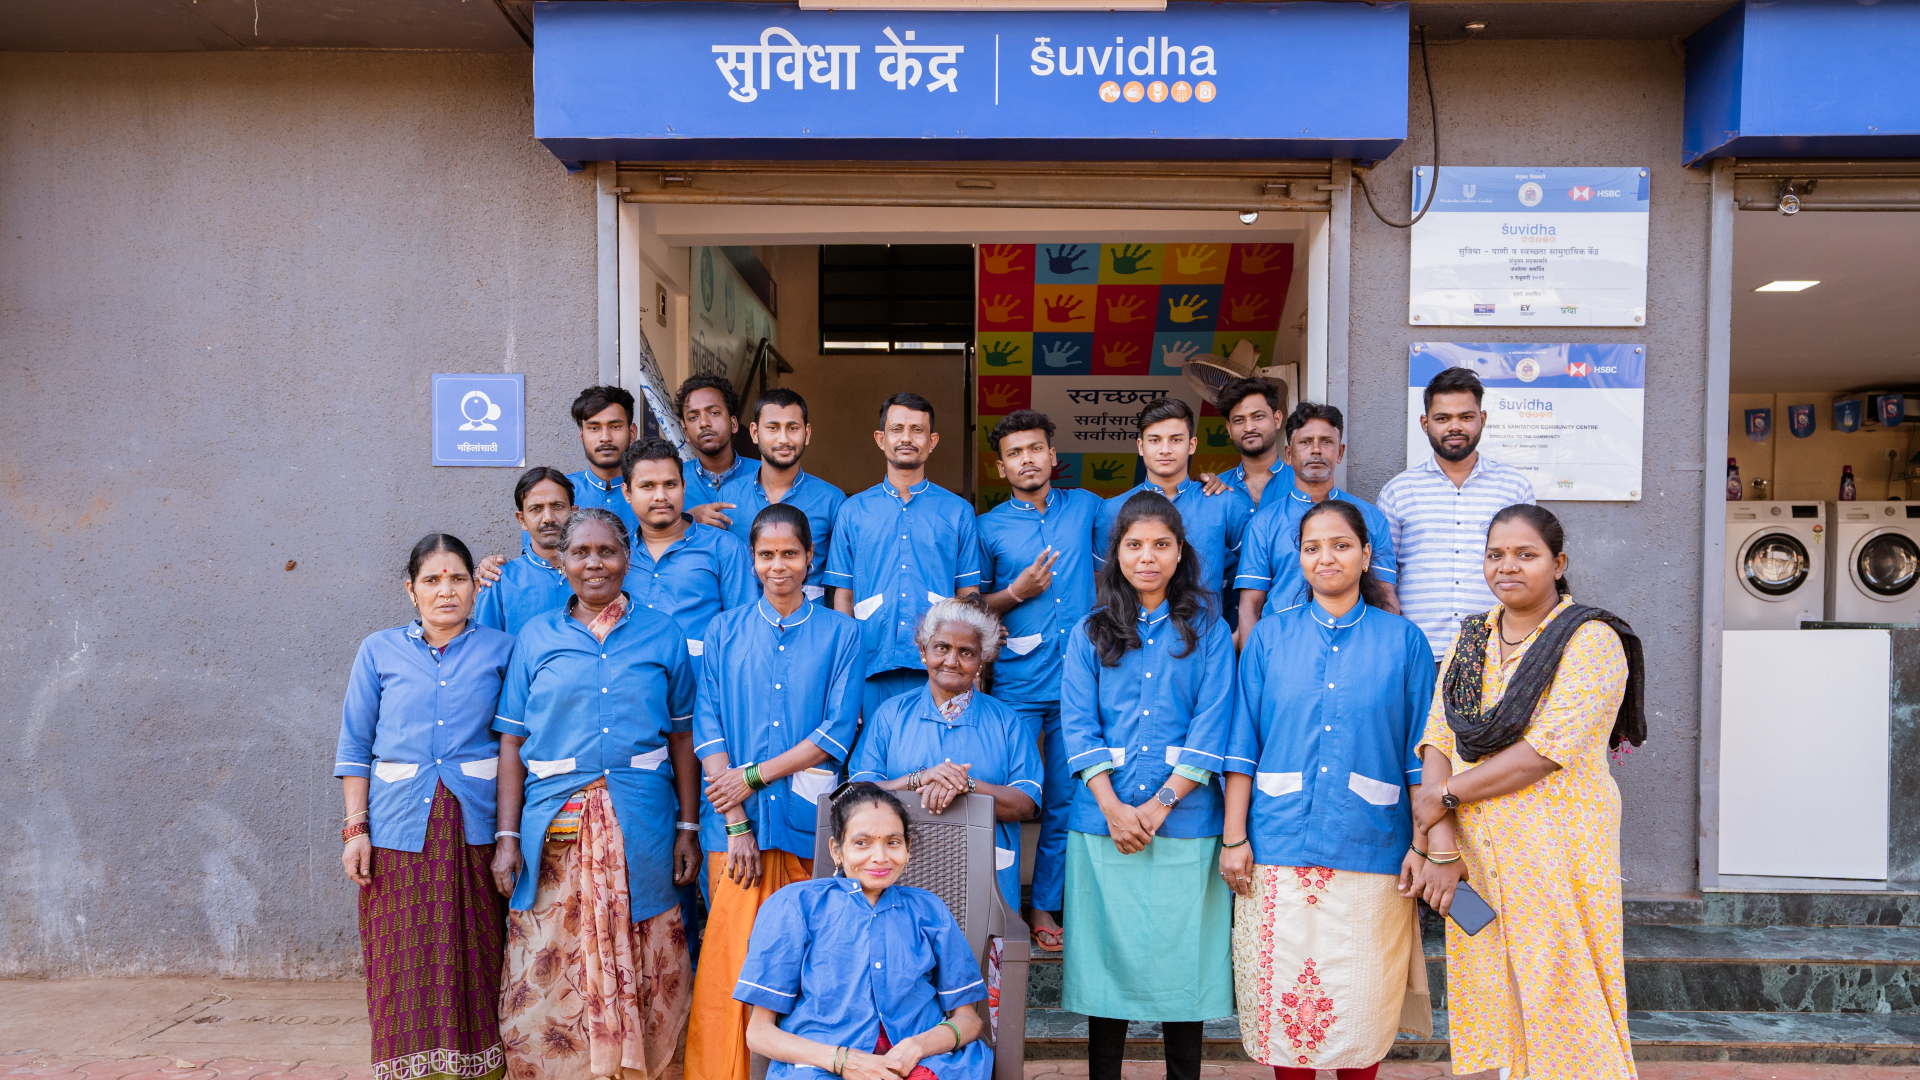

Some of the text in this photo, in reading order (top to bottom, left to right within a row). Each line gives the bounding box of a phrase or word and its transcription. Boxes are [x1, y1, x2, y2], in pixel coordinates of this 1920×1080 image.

[711, 26, 964, 103] सुविधा केंद्र
[1597, 189, 1621, 198] HSBC
[1458, 246, 1481, 257] सुविधा
[1491, 246, 1509, 255] पाणी
[1519, 248, 1547, 256] स्वच्छता
[1520, 304, 1531, 312] EY
[1594, 366, 1617, 374] HSBC
[1066, 389, 1169, 404] स्वच्छता
[457, 441, 498, 452] महिलांसाठी
